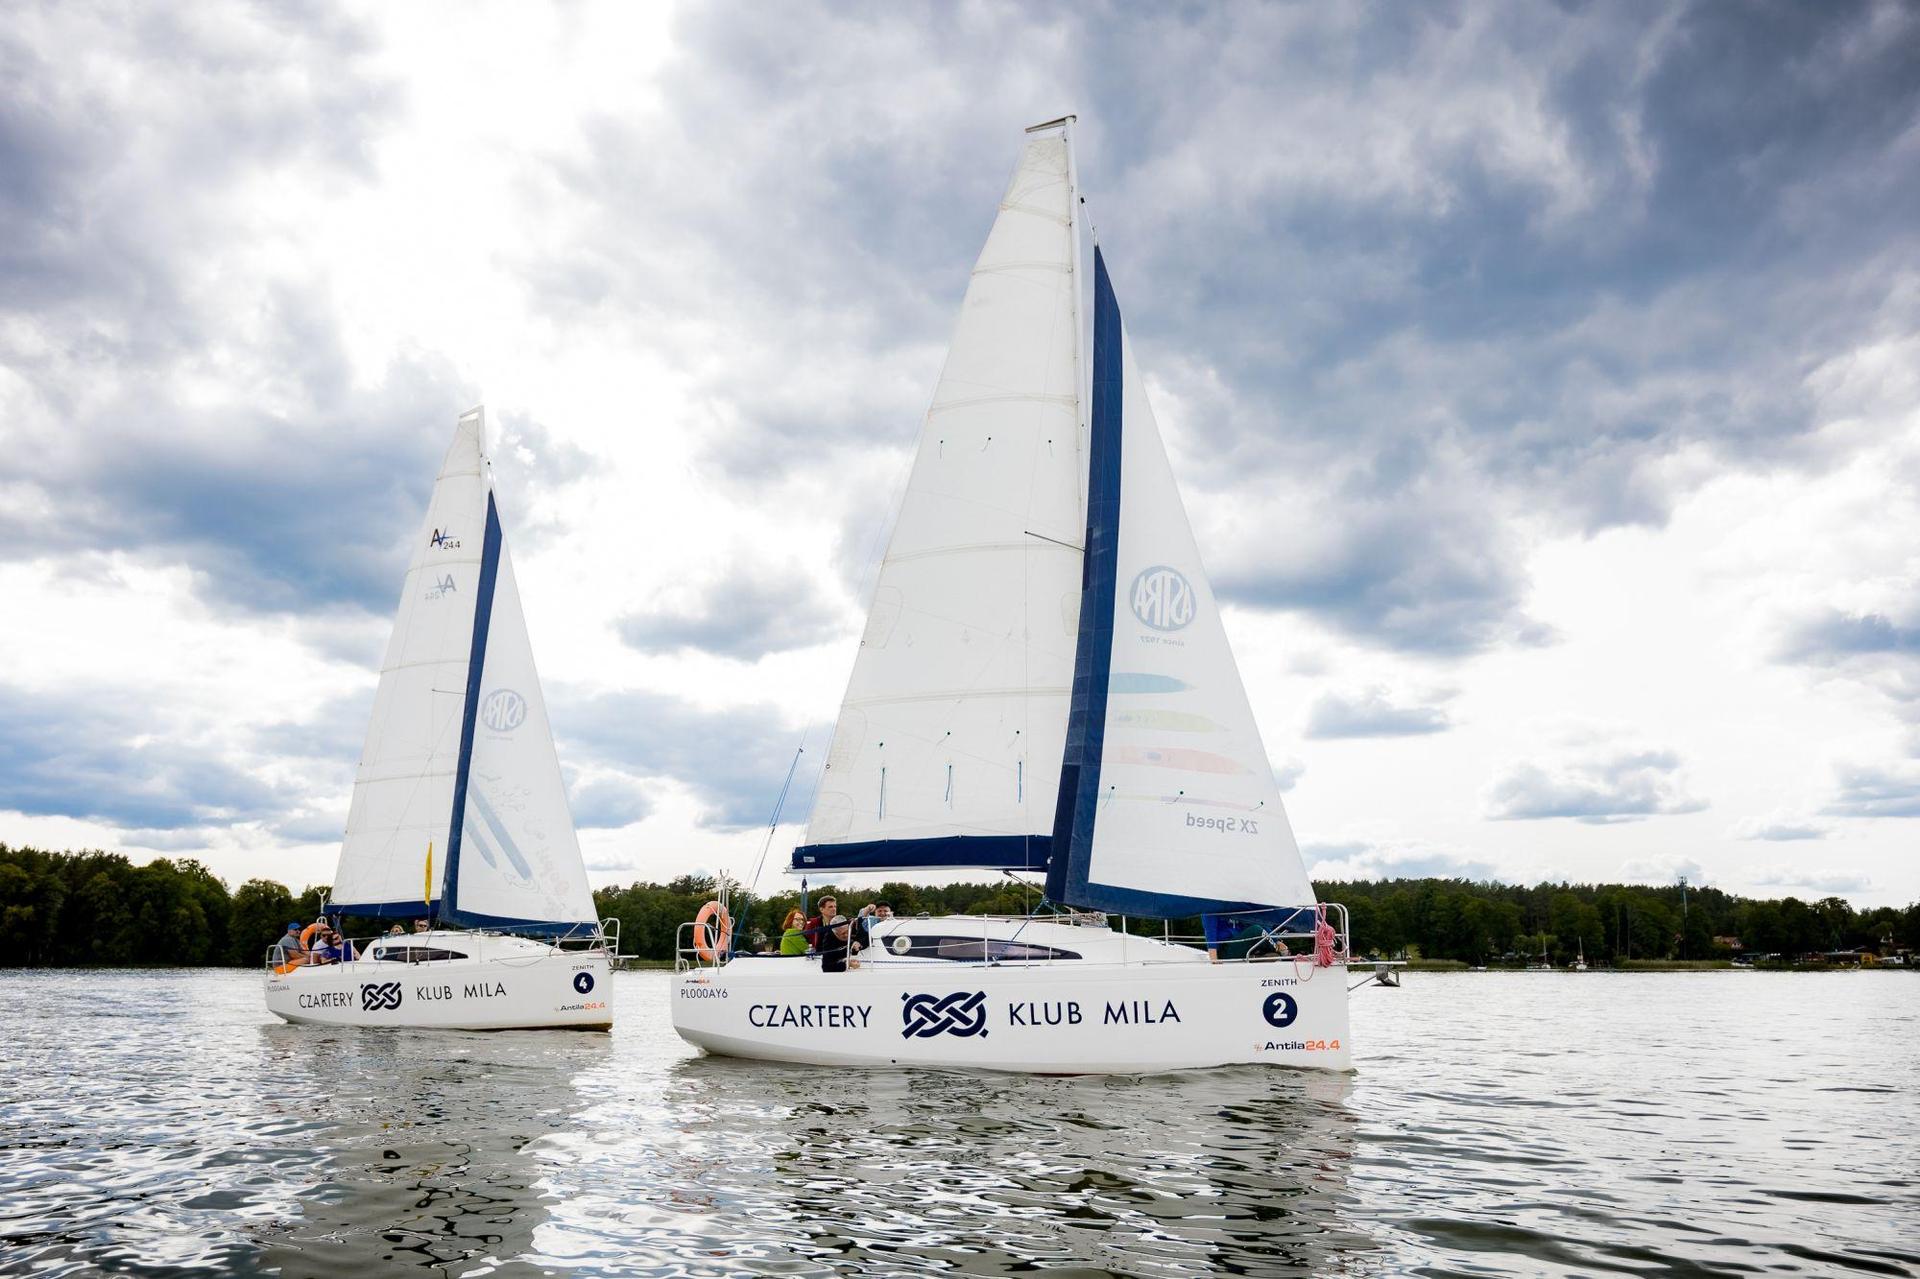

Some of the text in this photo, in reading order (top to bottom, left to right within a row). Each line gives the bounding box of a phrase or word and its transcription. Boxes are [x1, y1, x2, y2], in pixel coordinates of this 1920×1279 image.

[579, 976, 588, 990] 4
[1261, 978, 1298, 987] ZENITH
[298, 981, 507, 1009] CZARTERY KLUB MILA
[680, 988, 729, 999] PL000AY6
[748, 999, 1182, 1028] CZARTERY KLUB MILA
[1272, 998, 1289, 1020] 2
